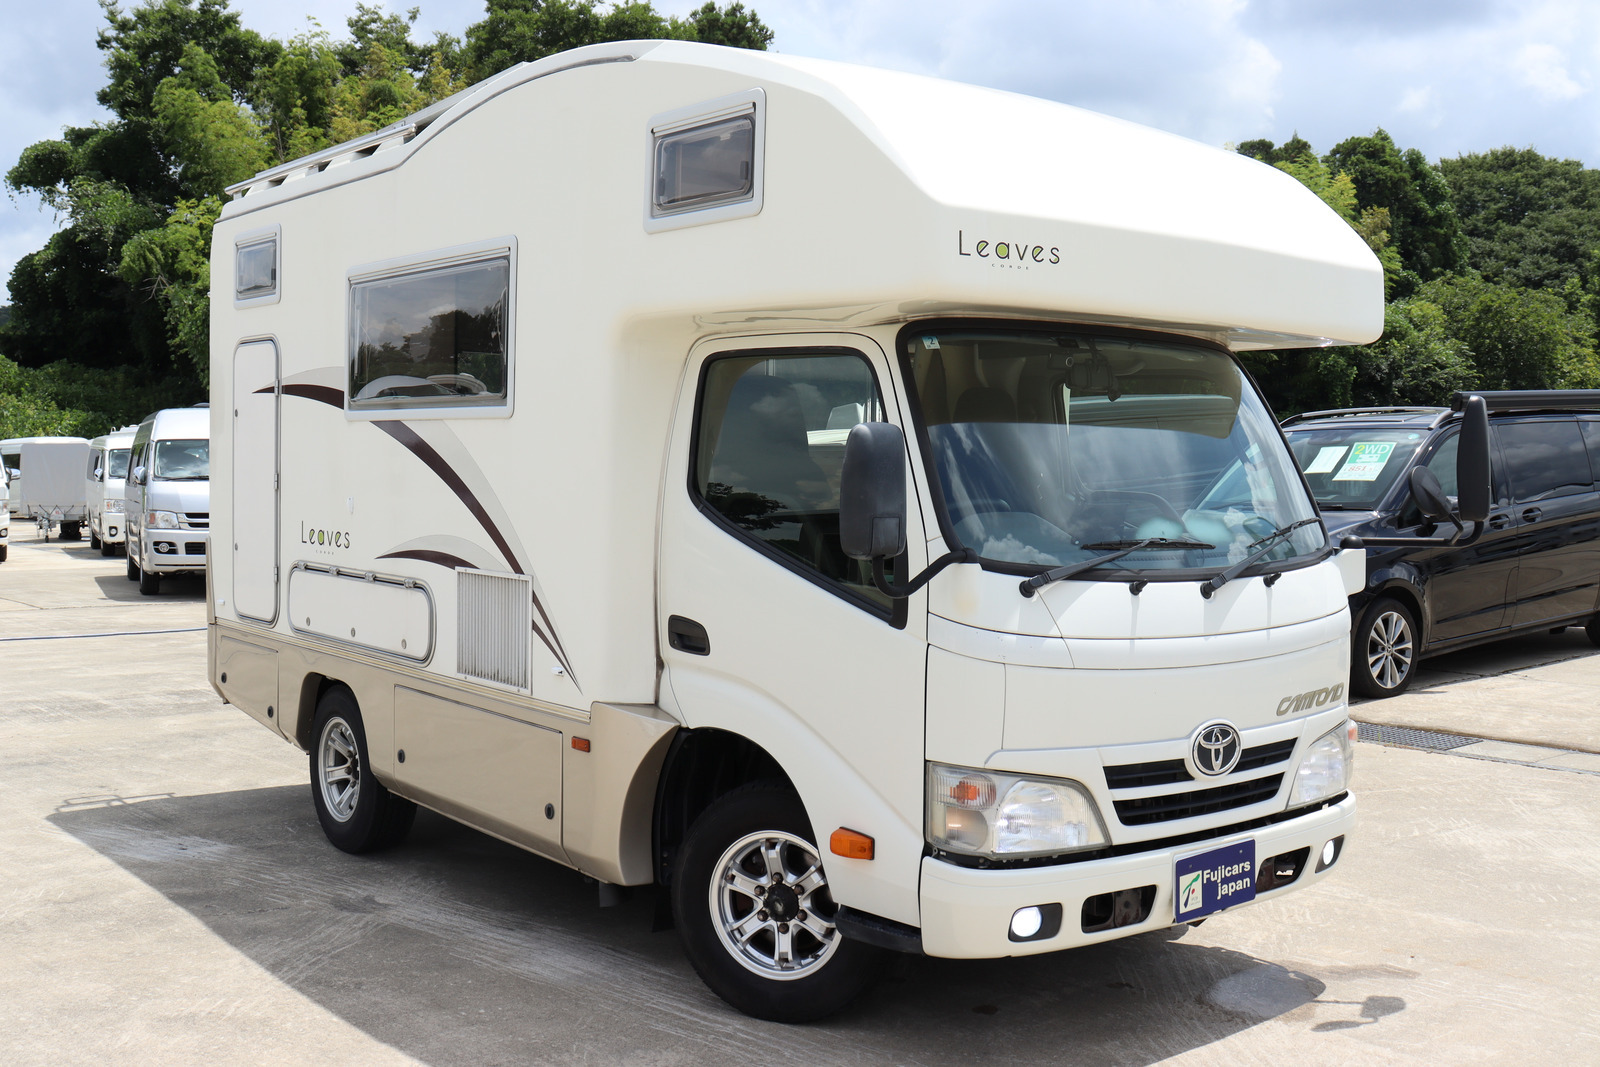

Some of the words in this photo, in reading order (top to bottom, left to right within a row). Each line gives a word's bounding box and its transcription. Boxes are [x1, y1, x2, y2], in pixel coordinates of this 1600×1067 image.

[958, 229, 1060, 265] Leaves
[1354, 444, 1391, 455] 2WD
[301, 520, 350, 549] Leaves
[1203, 860, 1251, 884] Fujicars
[1217, 877, 1251, 900] japan
